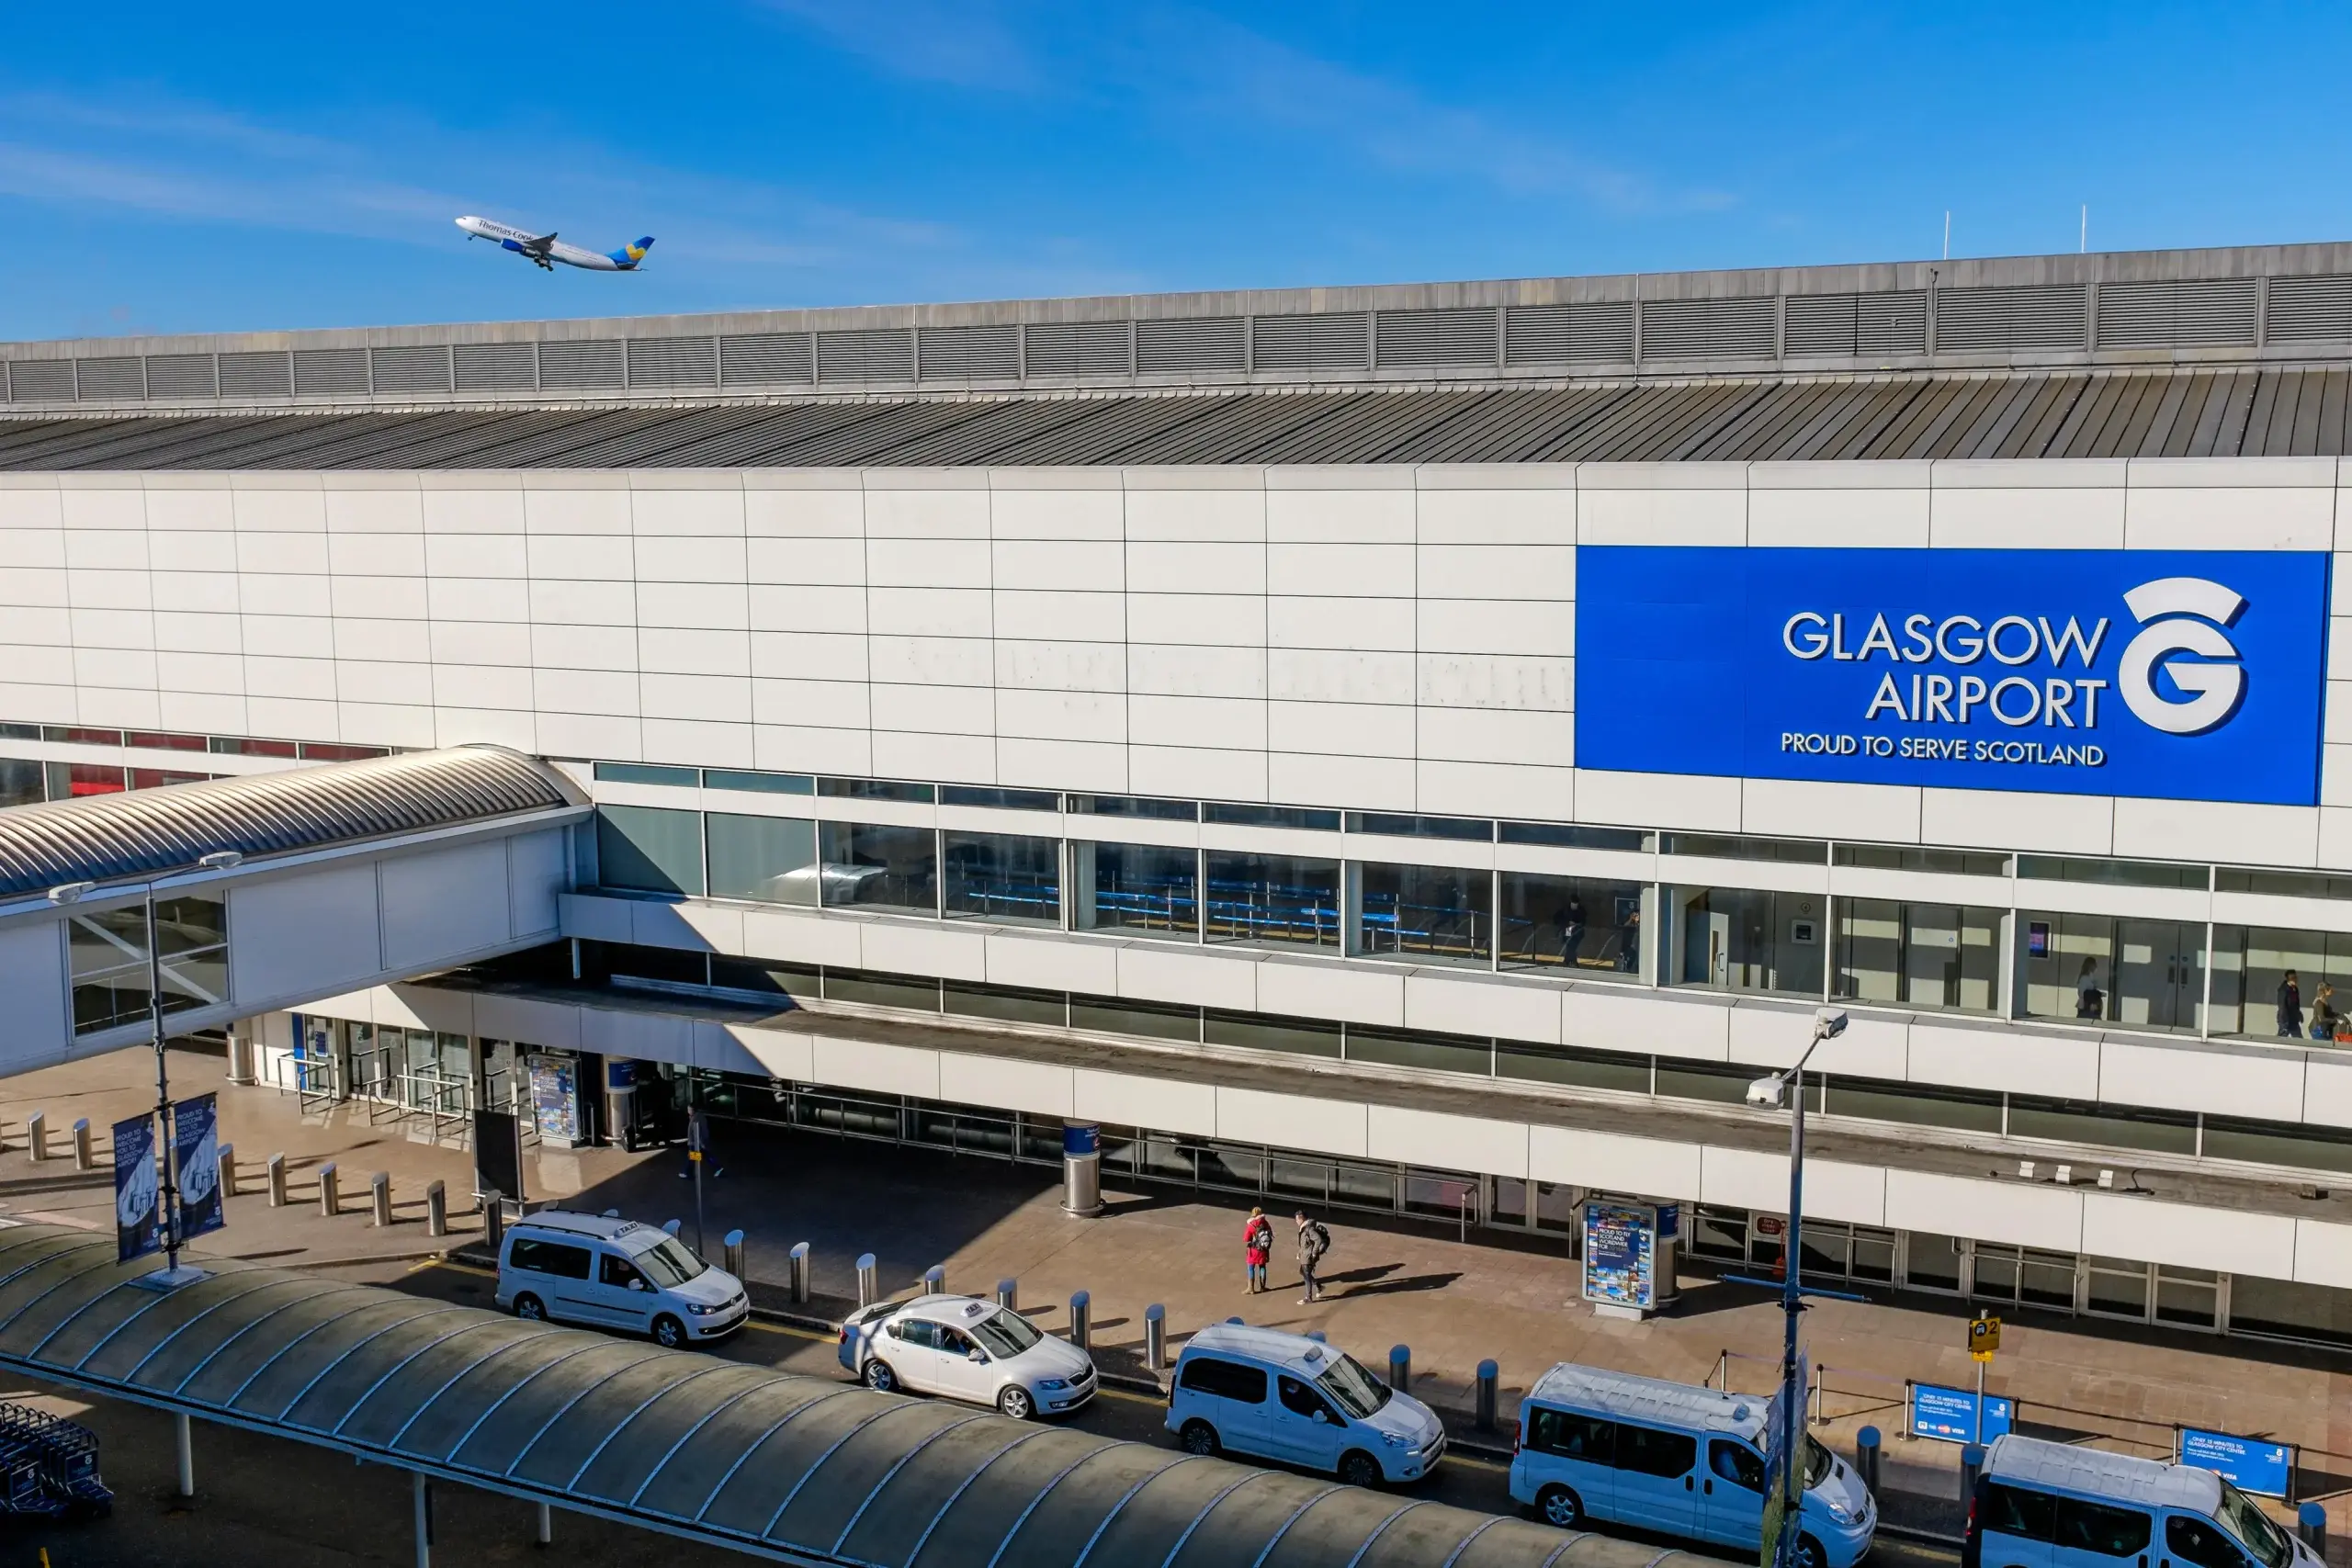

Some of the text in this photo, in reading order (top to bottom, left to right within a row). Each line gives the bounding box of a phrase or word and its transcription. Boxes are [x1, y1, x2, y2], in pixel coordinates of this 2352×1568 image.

[479, 220, 512, 236] Thomas
[1783, 612, 2108, 668] GLASGOW
[1866, 671, 2107, 728] AIRPORT
[1781, 732, 2104, 766] PROUD TO SERVE SCOTLAND
[618, 1223, 638, 1234] TAXI
[1599, 1234, 1625, 1242] SCOTLAND
[966, 1303, 979, 1314] TAXI
[1989, 1321, 1997, 1334] 2
[2188, 1440, 2214, 1450] GLASGOW
